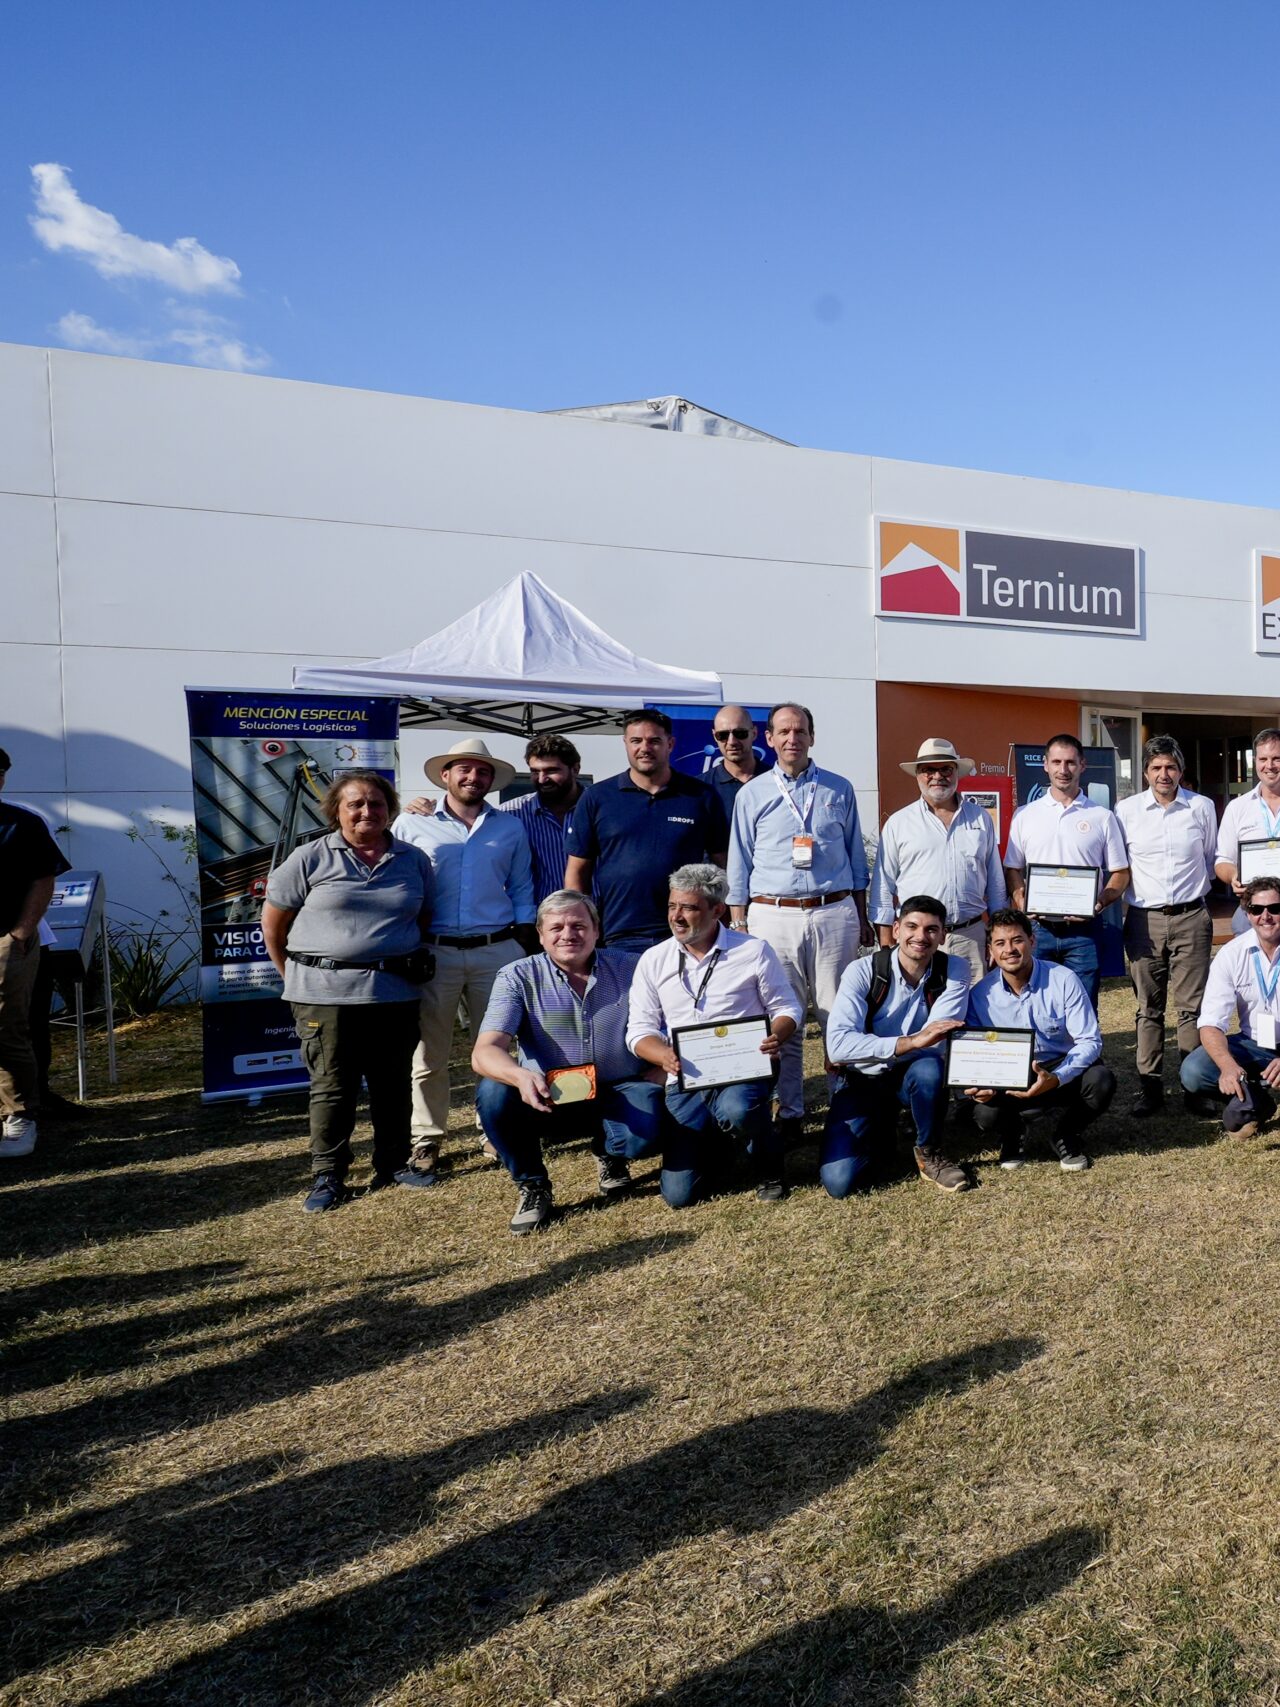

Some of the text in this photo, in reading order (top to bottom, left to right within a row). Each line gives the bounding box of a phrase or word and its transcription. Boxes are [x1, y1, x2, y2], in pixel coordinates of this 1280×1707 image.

[973, 563, 1122, 616] Ternium
[223, 706, 369, 721] MENCIÓN ESPECIAL
[239, 720, 357, 733] Soluciones Logísticas
[1024, 754, 1041, 762] RICE
[980, 762, 1005, 774] Premio
[214, 947, 253, 958] PARA
